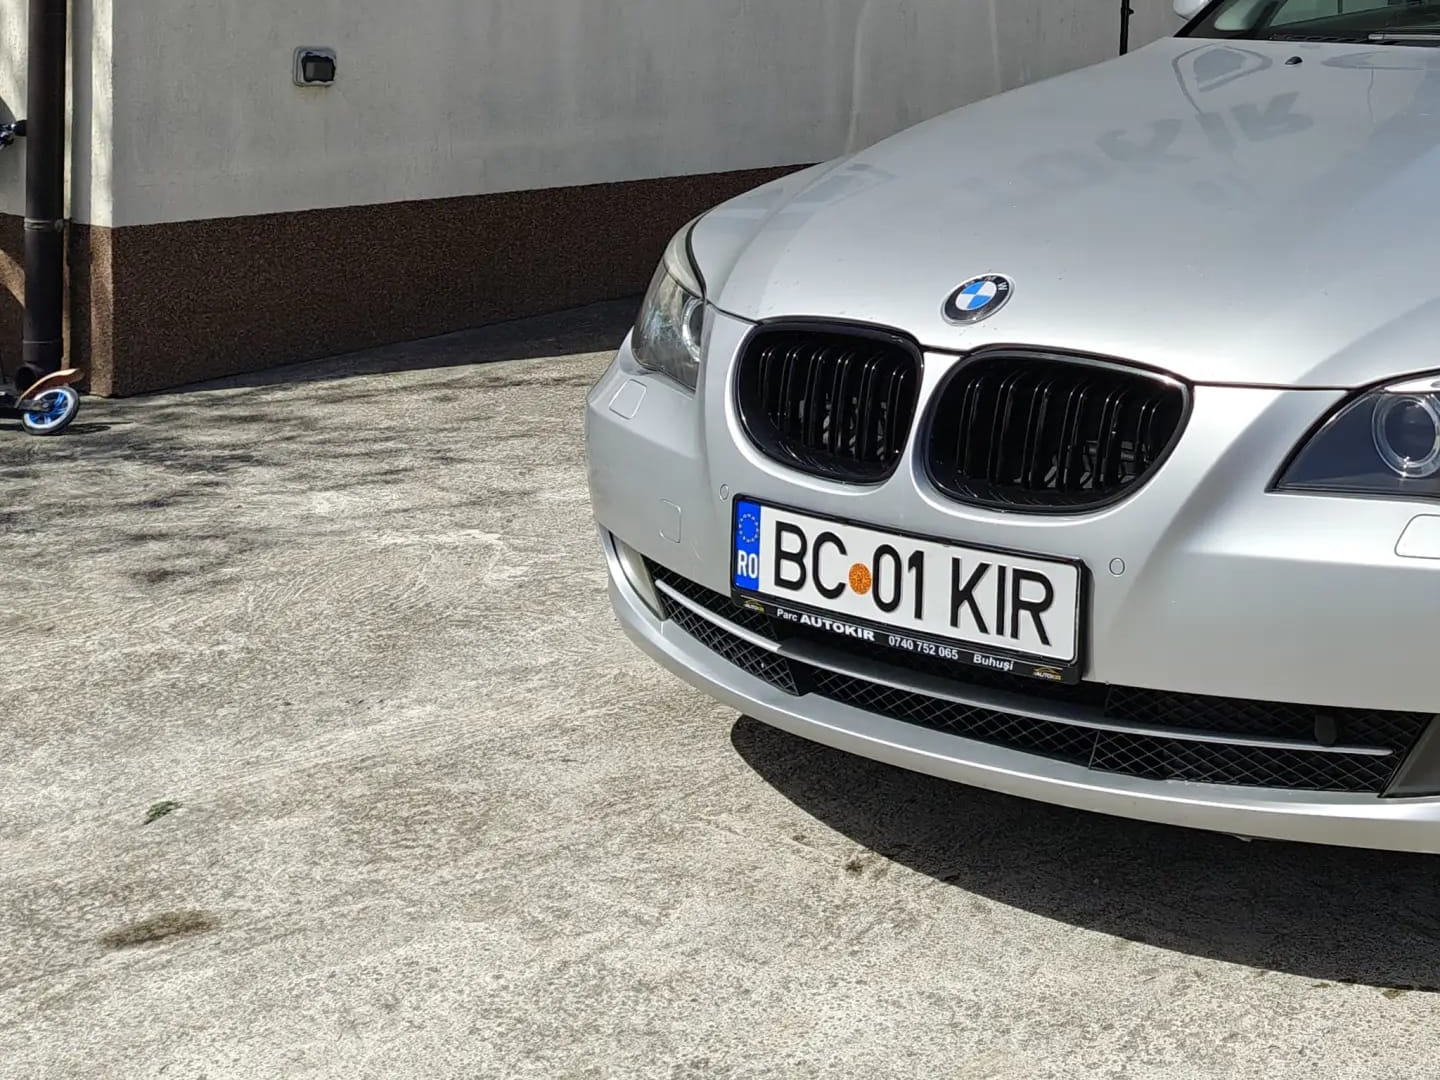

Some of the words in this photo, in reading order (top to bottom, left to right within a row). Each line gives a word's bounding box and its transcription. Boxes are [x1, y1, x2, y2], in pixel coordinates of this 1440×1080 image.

[737, 549, 758, 579] RO
[774, 520, 848, 600] BC
[872, 543, 925, 621] 01
[949, 556, 1054, 647] KIR
[776, 608, 798, 621] Parc
[800, 614, 875, 641] AUTOKIR
[888, 635, 914, 650] 0740
[917, 641, 936, 656] 752
[938, 646, 959, 660] 065
